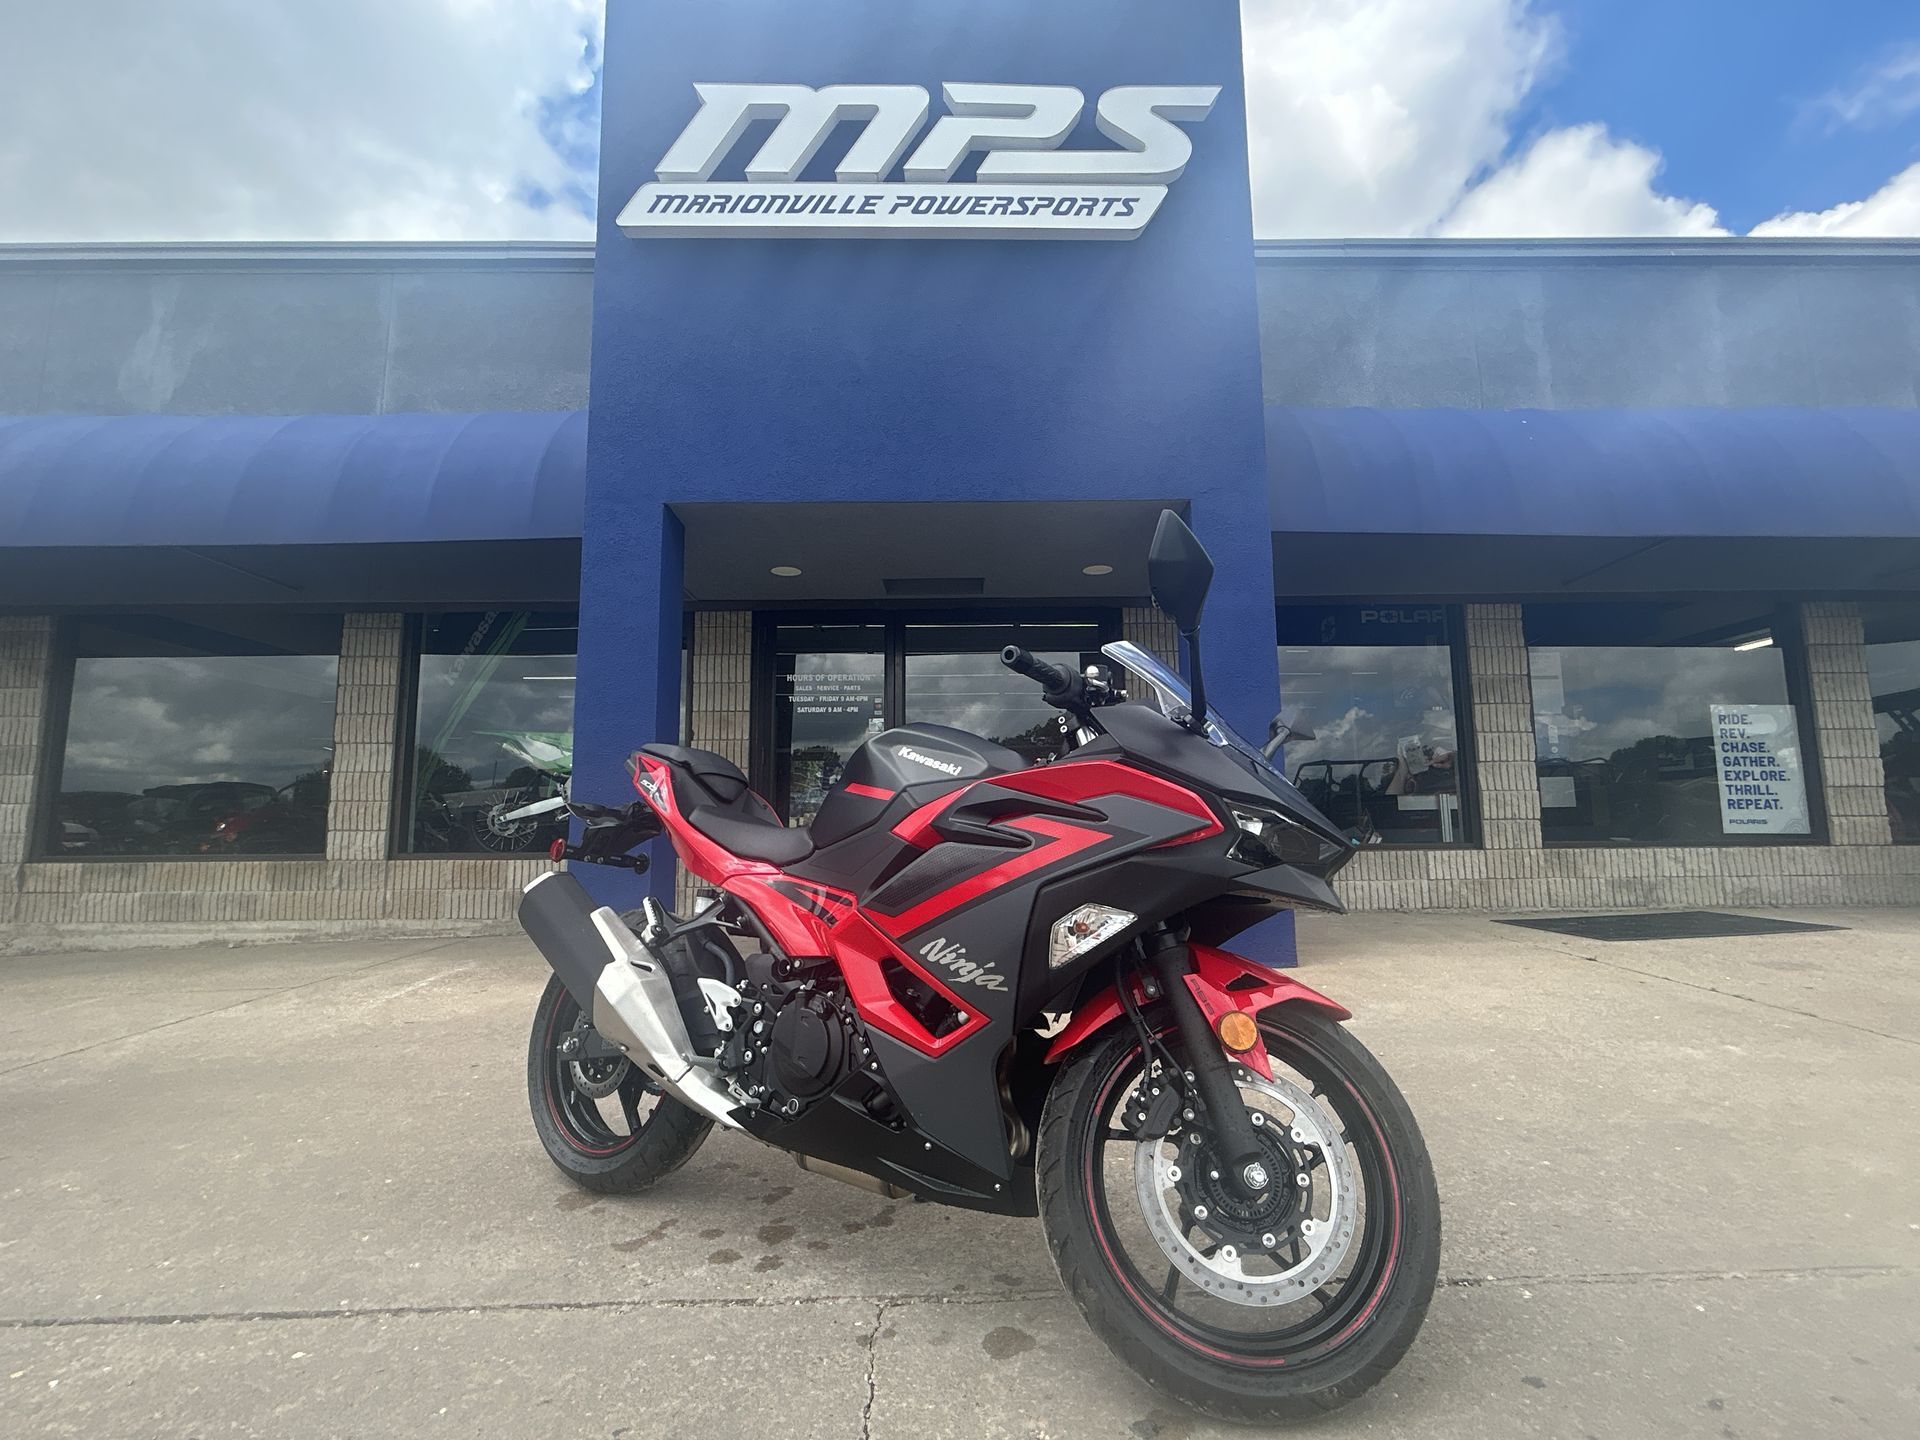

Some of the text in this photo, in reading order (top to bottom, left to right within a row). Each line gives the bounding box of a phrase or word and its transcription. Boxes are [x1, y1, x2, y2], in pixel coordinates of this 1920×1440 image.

[654, 81, 1222, 183] MPS
[646, 193, 1141, 218] MARIONVILLE POWERSPORTS
[786, 674, 813, 682] HOURS
[815, 674, 825, 682] OF
[1718, 714, 1753, 725] RIDE.
[1720, 728, 1750, 739] REV.
[1721, 742, 1770, 753] CHASE.
[898, 746, 963, 777] Kawasaki
[1723, 756, 1780, 767] GATHER.
[1724, 770, 1791, 781] EXPLORE.
[1726, 784, 1778, 795] THRILL.
[1728, 798, 1783, 810] REPEAT.
[920, 937, 1008, 991] Ninja
